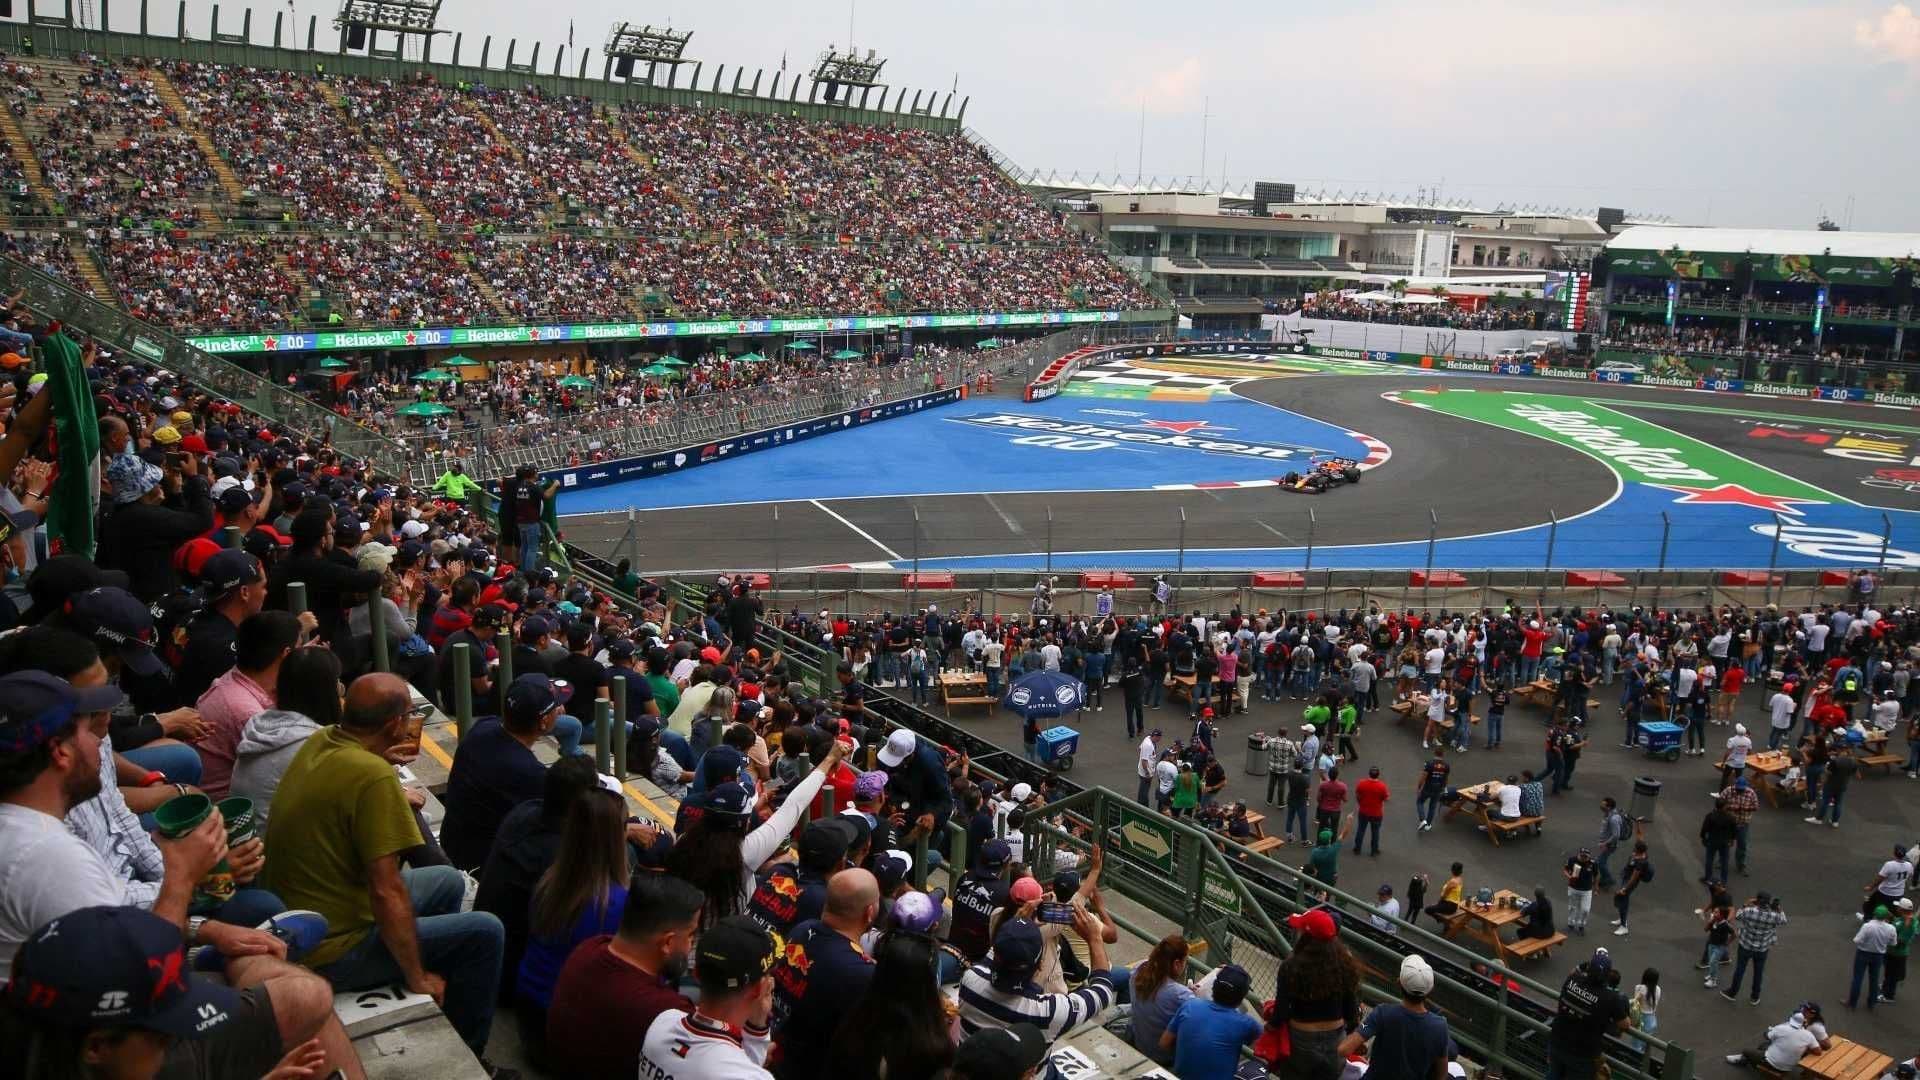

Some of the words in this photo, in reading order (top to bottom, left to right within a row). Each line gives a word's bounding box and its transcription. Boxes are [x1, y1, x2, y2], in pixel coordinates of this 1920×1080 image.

[689, 321, 736, 334] Heineken
[782, 318, 825, 330] Heineken
[468, 326, 526, 343] Heineken
[585, 324, 636, 338] Heineken
[335, 330, 400, 347] Heineken
[1322, 348, 1360, 358] Heineken
[1447, 360, 1490, 371] Heineken
[1541, 367, 1587, 379] Heineken
[1642, 375, 1693, 387] Heineken
[1753, 383, 1808, 396] Heineken
[968, 413, 1295, 458] Heineken
[1567, 979, 1599, 1004] Mexican
